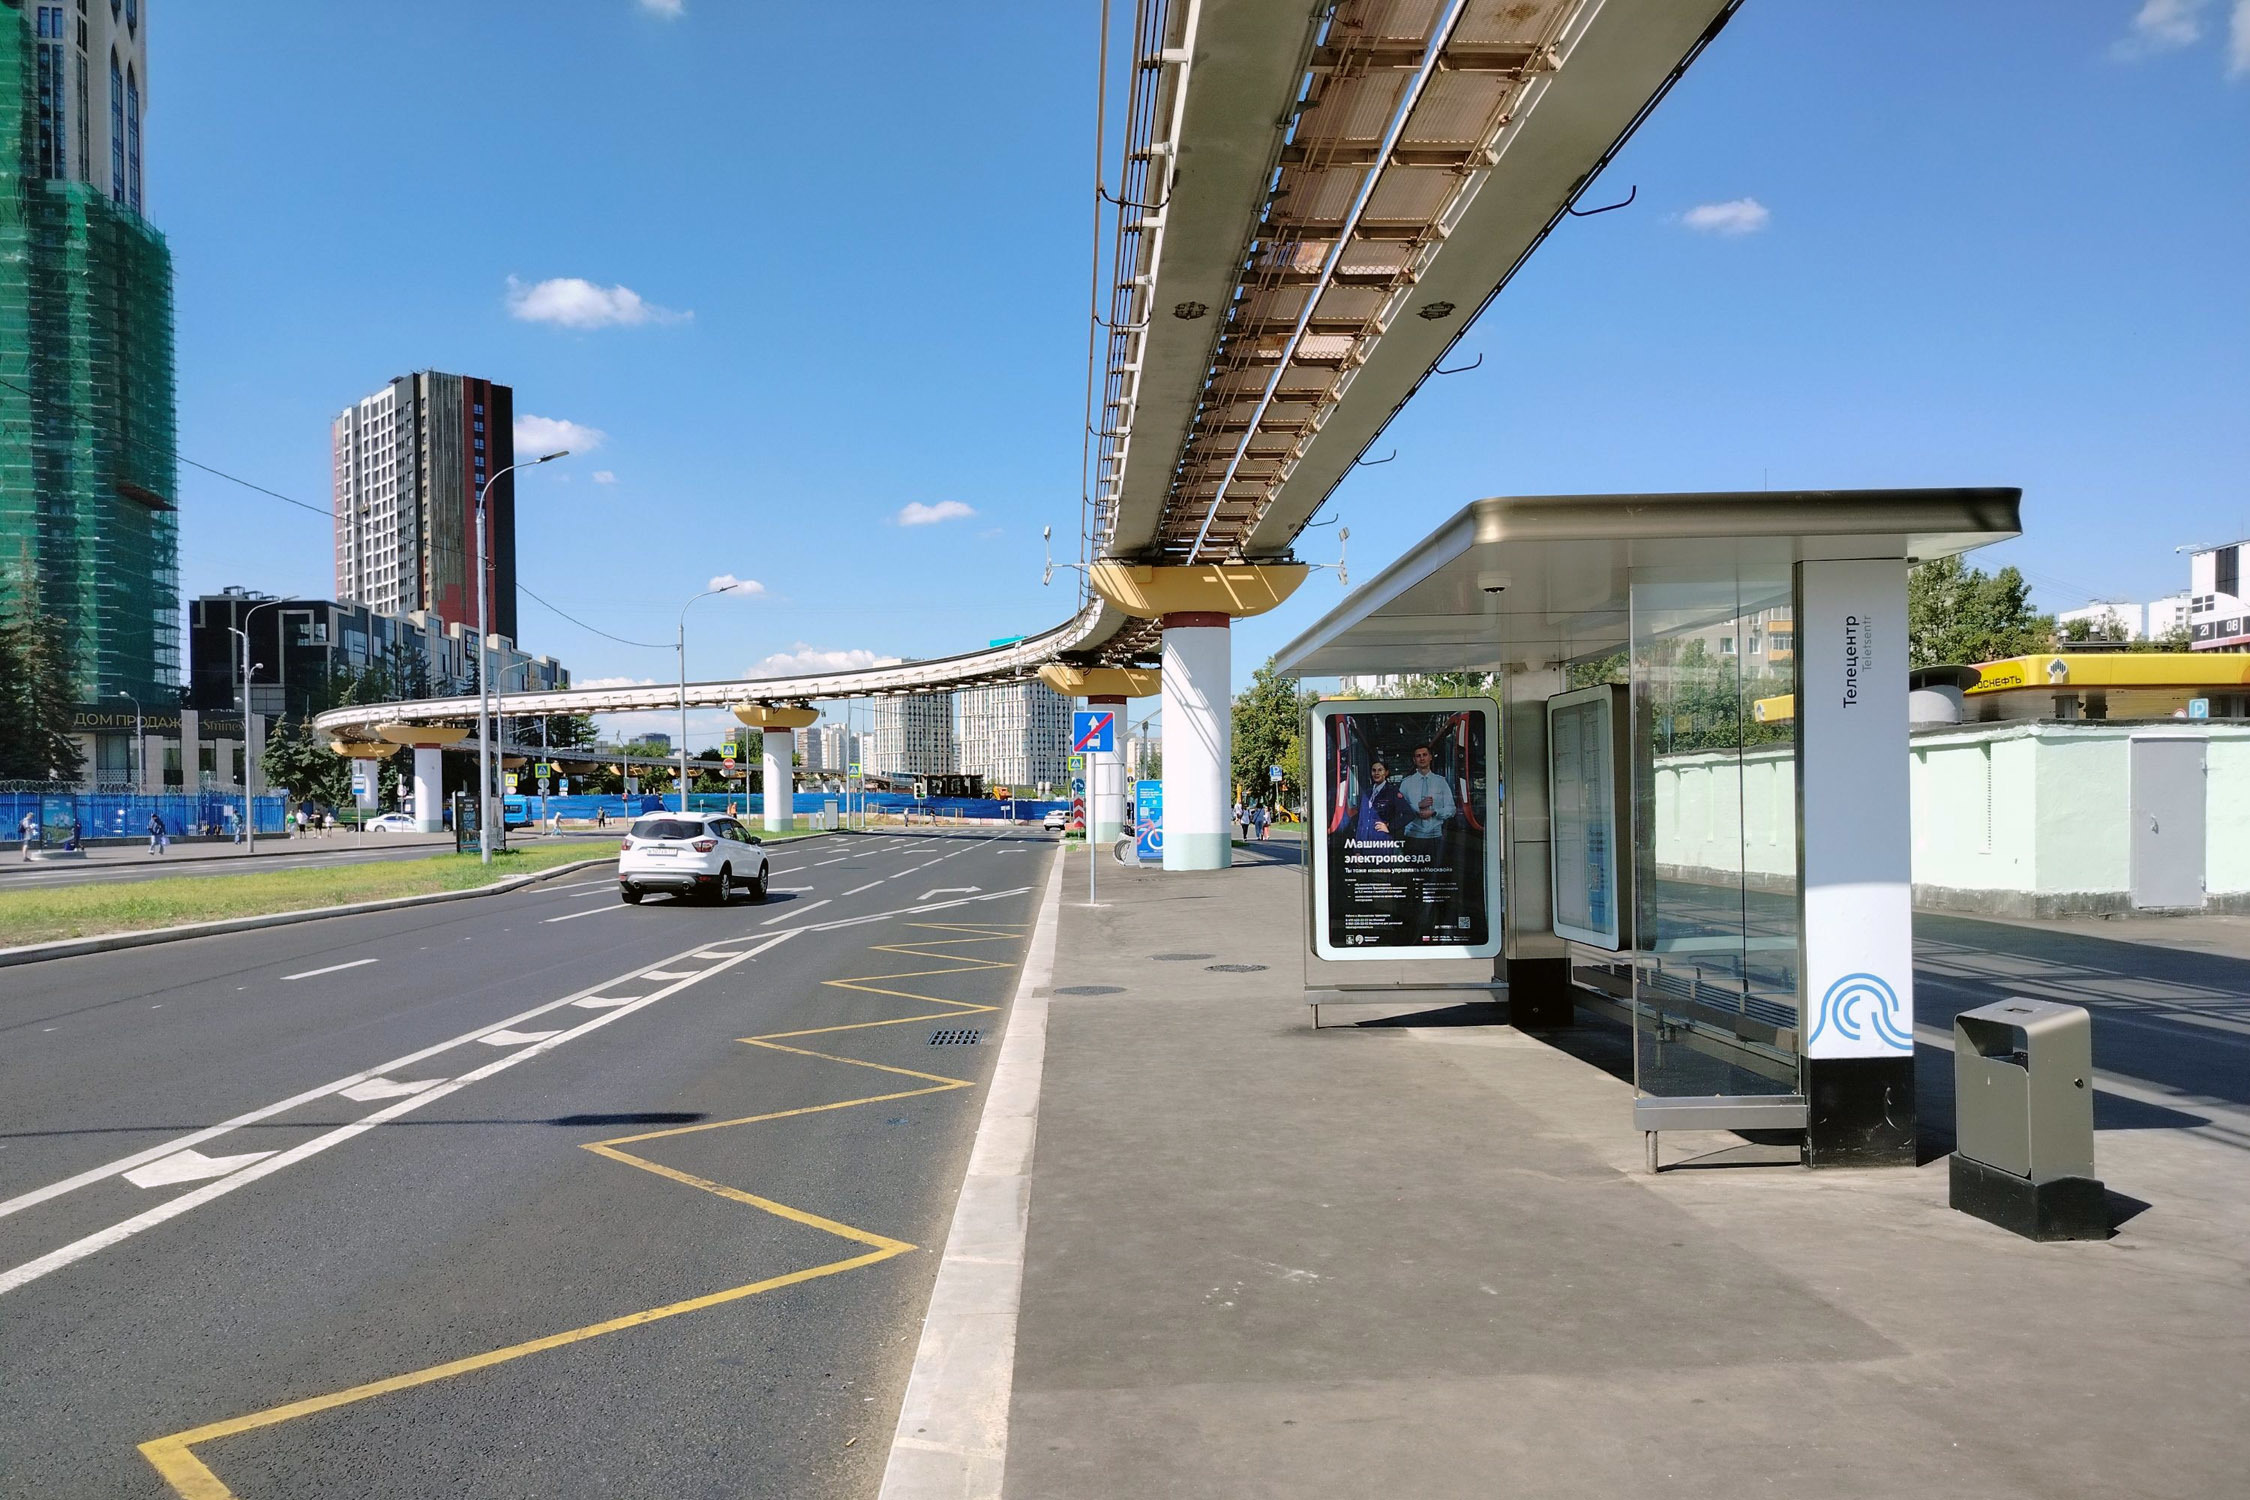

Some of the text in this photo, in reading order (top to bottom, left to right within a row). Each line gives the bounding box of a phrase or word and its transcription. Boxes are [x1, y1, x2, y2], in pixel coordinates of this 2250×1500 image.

[1862, 615, 1872, 672] Teletsentr
[1843, 615, 1860, 709] Телецентр
[1971, 675, 2022, 690] ОСНЕФТЬ
[73, 712, 113, 727] ДОМ
[1344, 838, 1406, 849] Машинист
[1344, 854, 1431, 865] электропоезда
